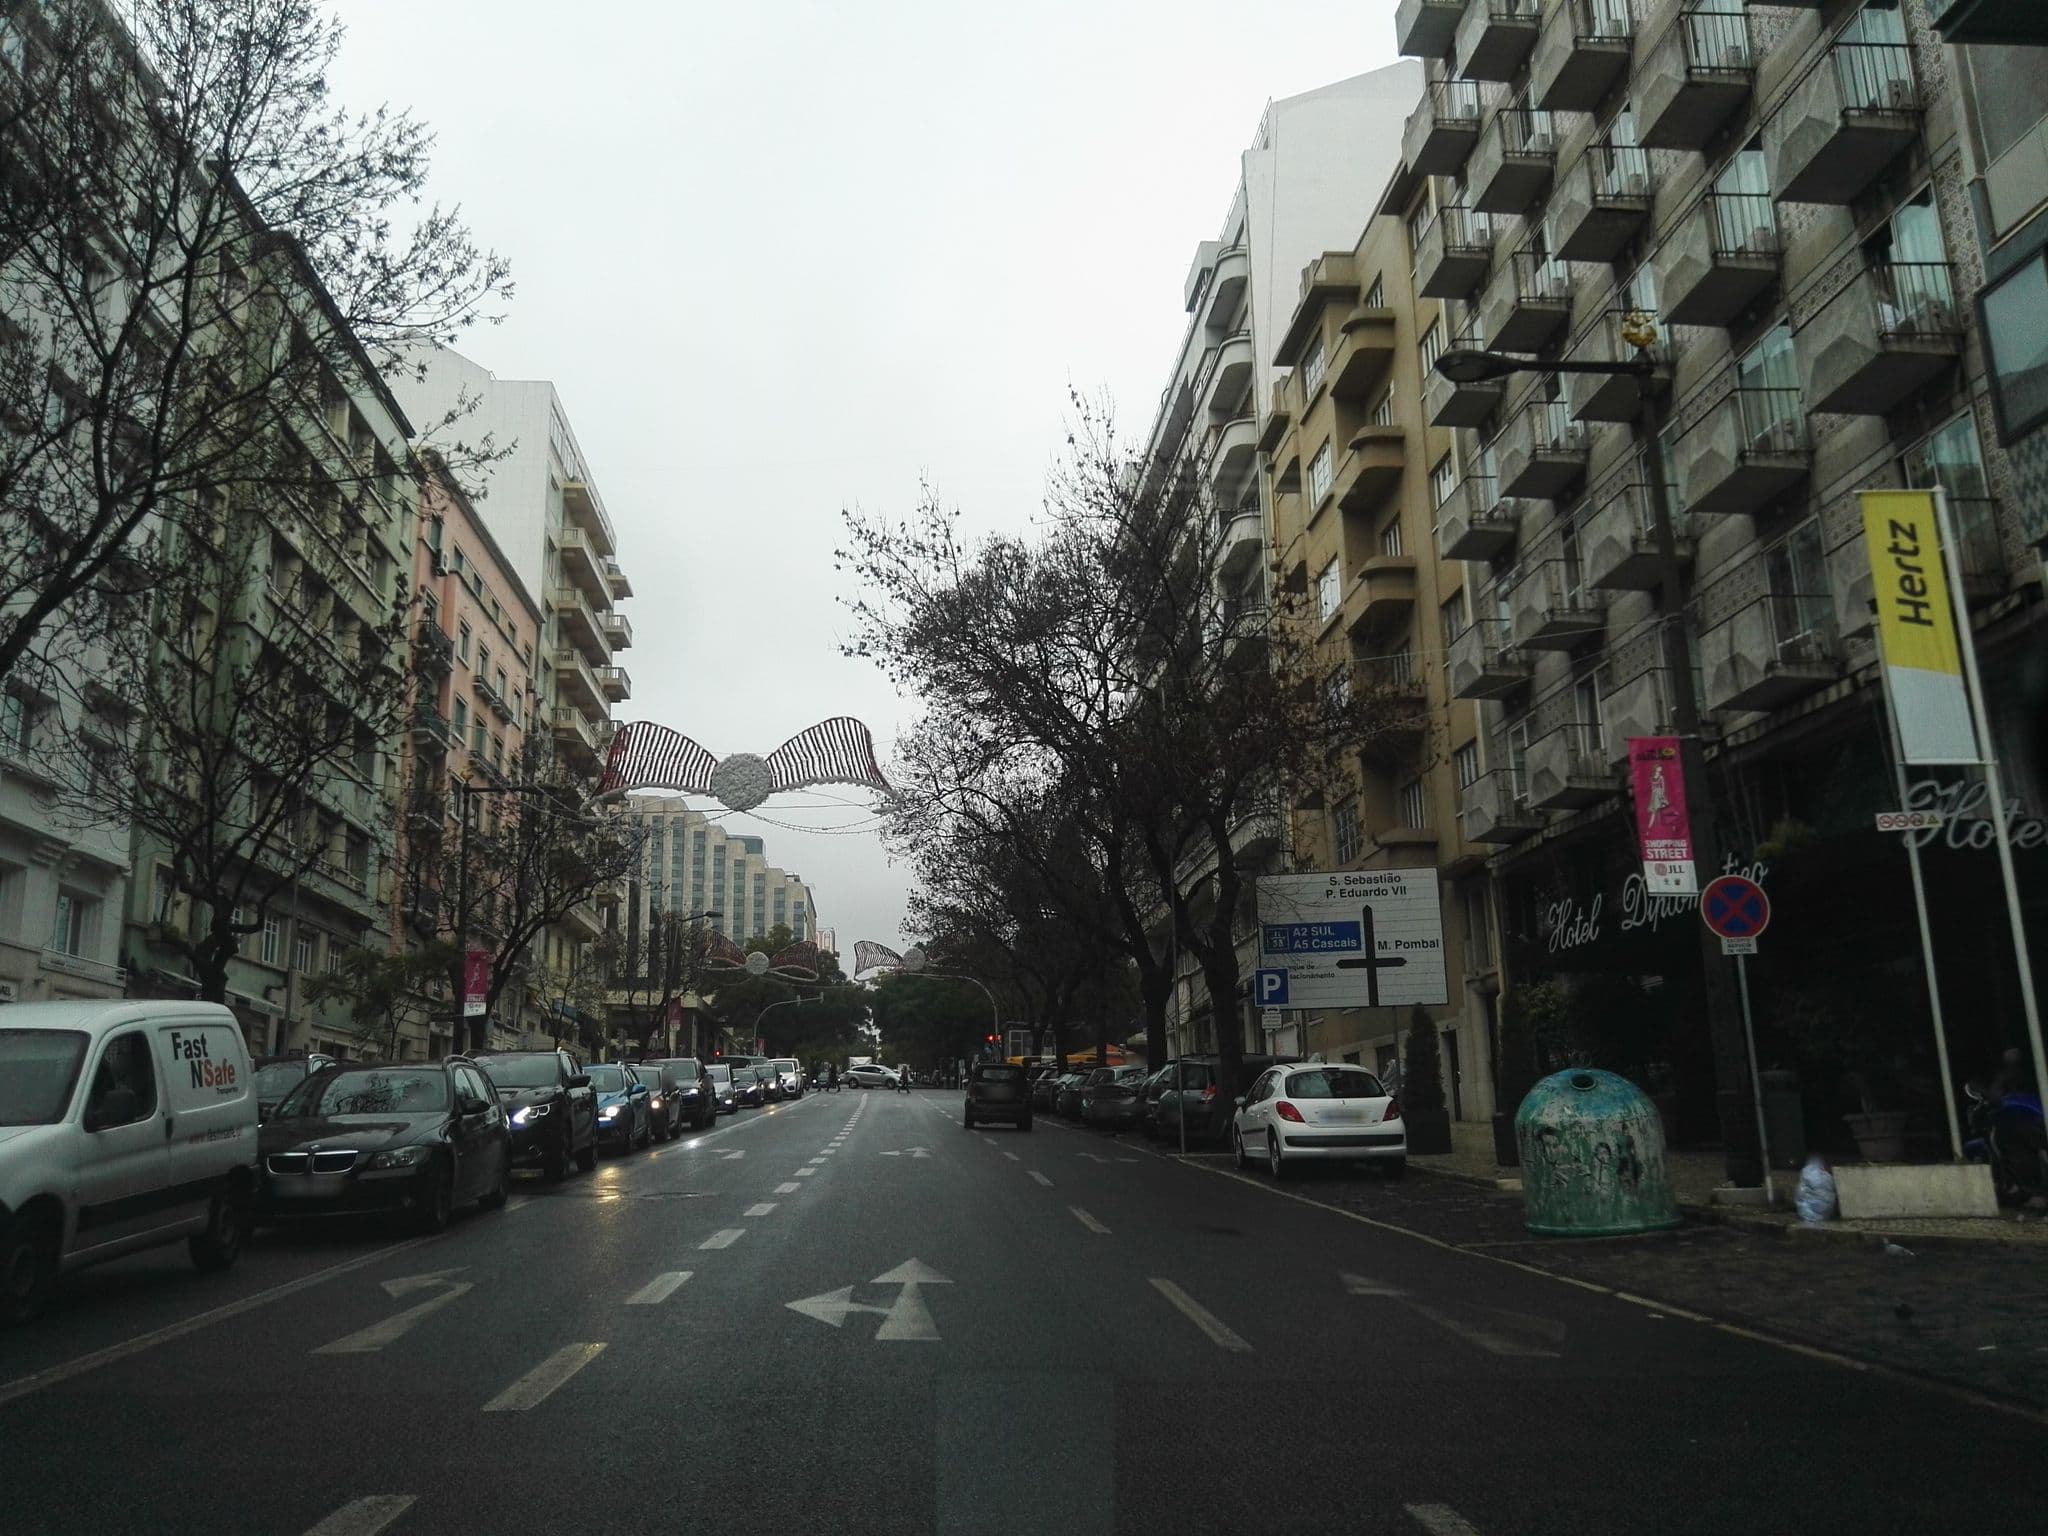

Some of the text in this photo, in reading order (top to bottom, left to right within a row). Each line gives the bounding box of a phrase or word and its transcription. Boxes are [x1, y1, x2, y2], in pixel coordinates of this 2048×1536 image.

[1888, 519, 1934, 627] Hertz
[1902, 779, 2048, 850] Hote
[1644, 839, 1687, 848] SHOPPING
[1646, 848, 1688, 859] STREET
[1329, 873, 1402, 886] S. Sebastião
[1326, 885, 1407, 899] P. Eduardo VII
[1549, 893, 1602, 953] Hotel
[1292, 926, 1335, 937] A2 SUL
[1292, 937, 1358, 950] A5 Cascais
[1377, 938, 1440, 950] M. Pombal
[1263, 973, 1281, 1000] P
[171, 1031, 209, 1060] Fast
